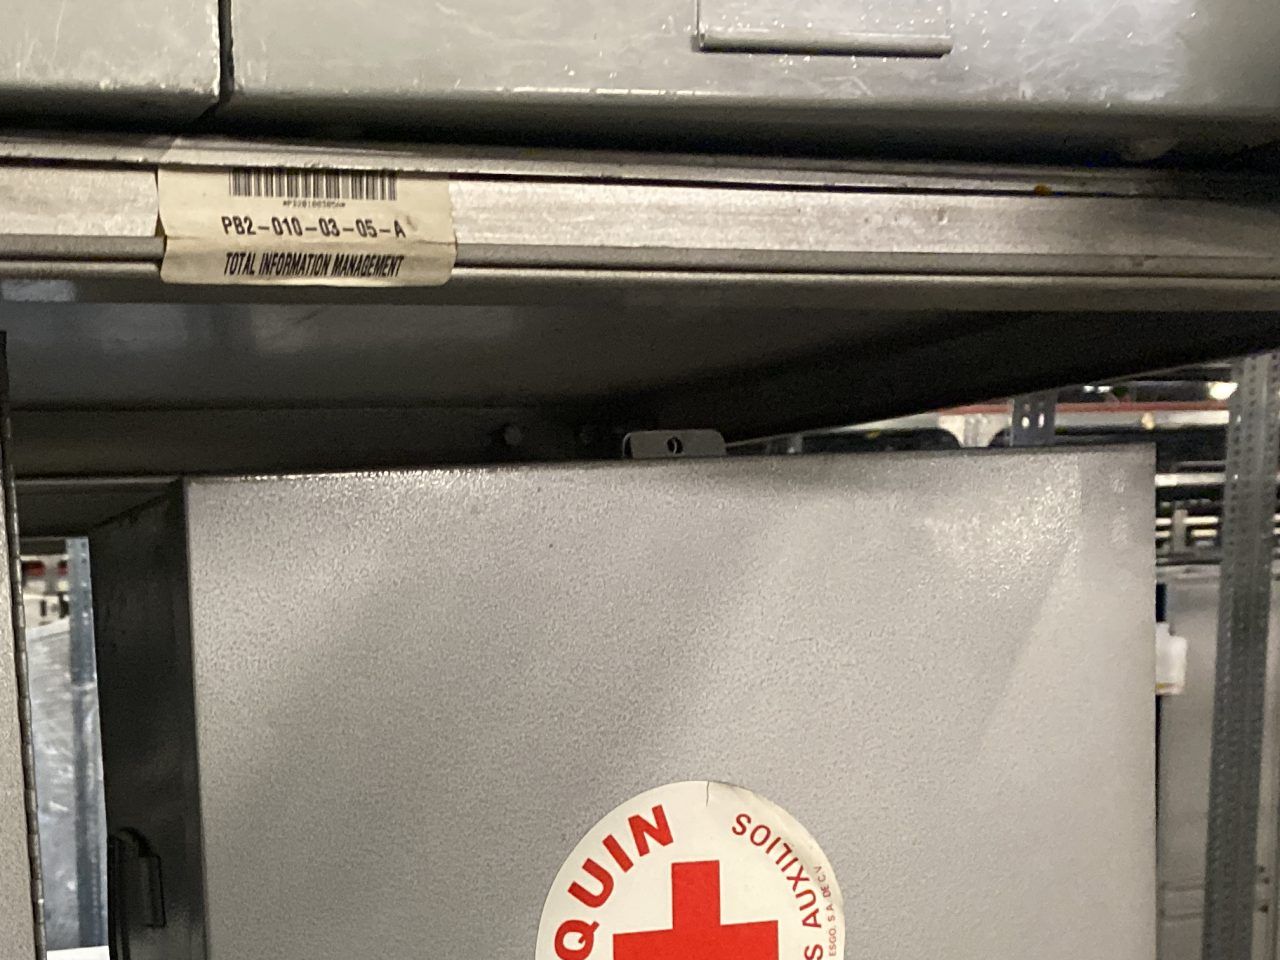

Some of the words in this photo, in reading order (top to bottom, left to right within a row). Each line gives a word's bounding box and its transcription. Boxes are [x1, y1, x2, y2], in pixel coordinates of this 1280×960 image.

[221, 215, 407, 239] PB2-010-03-05-A
[223, 251, 257, 276] TOTAL
[258, 252, 331, 277] INFORMATION
[330, 253, 406, 278] MANAGEMENT
[731, 813, 823, 930] AUXILIOS
